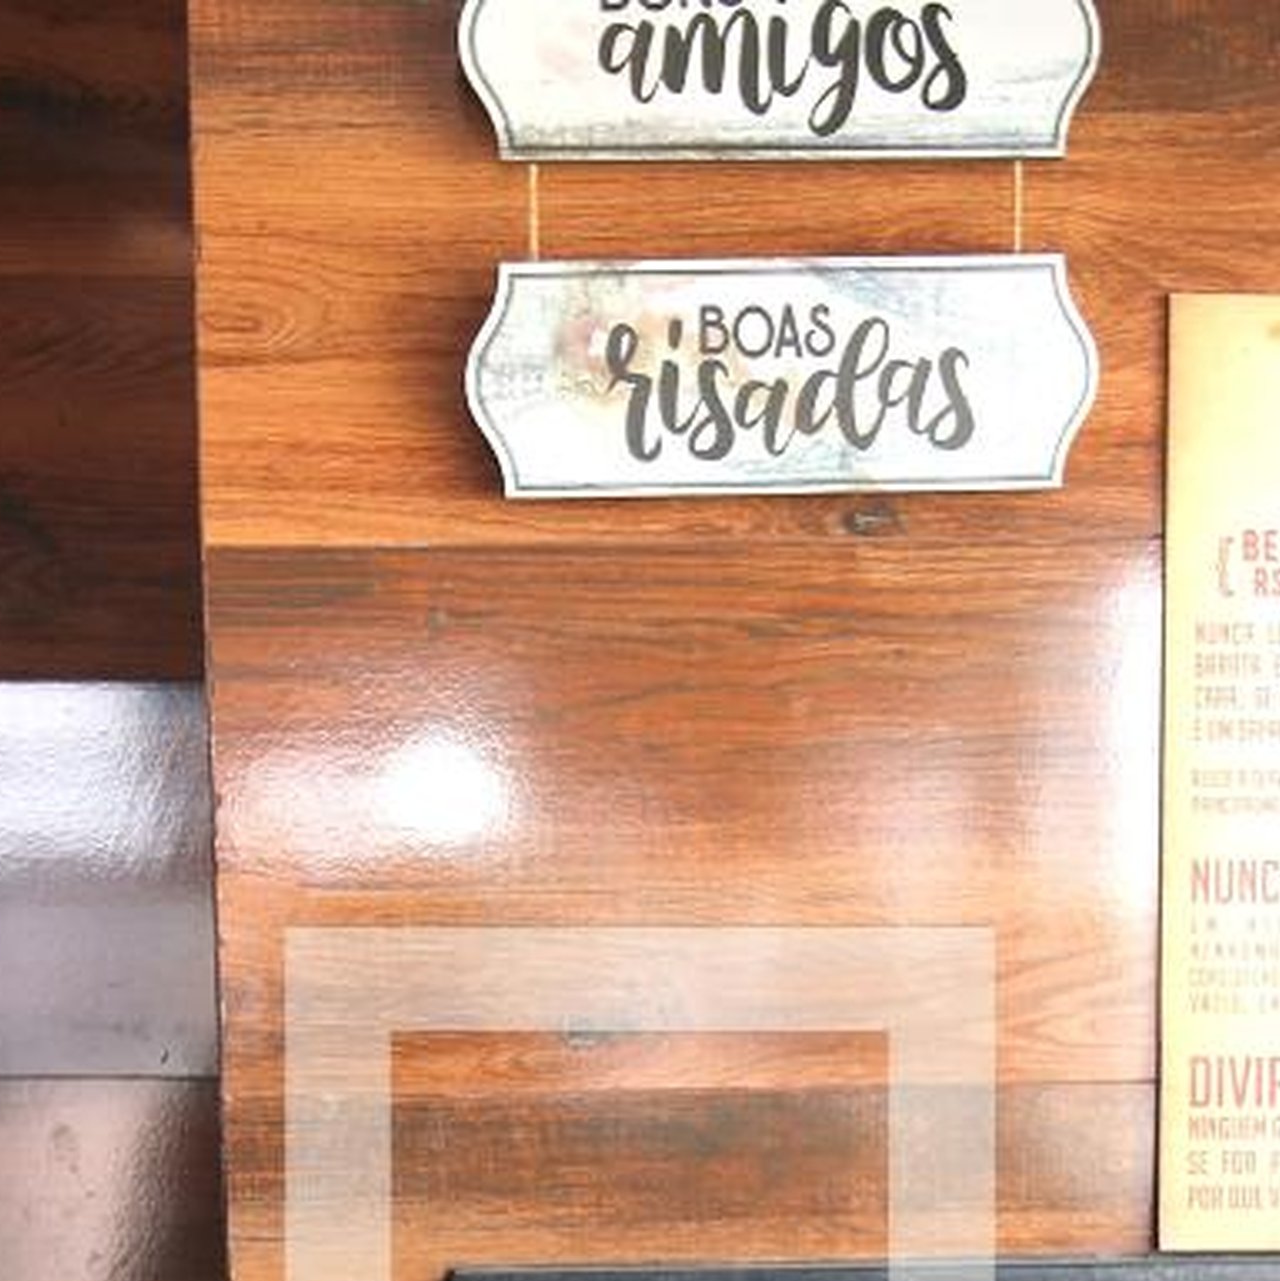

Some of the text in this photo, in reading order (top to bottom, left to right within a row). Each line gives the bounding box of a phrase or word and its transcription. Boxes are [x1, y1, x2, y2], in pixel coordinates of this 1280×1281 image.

[598, 0, 967, 137] amigos
[605, 316, 976, 462] risadas
[699, 304, 835, 359] BOAS
